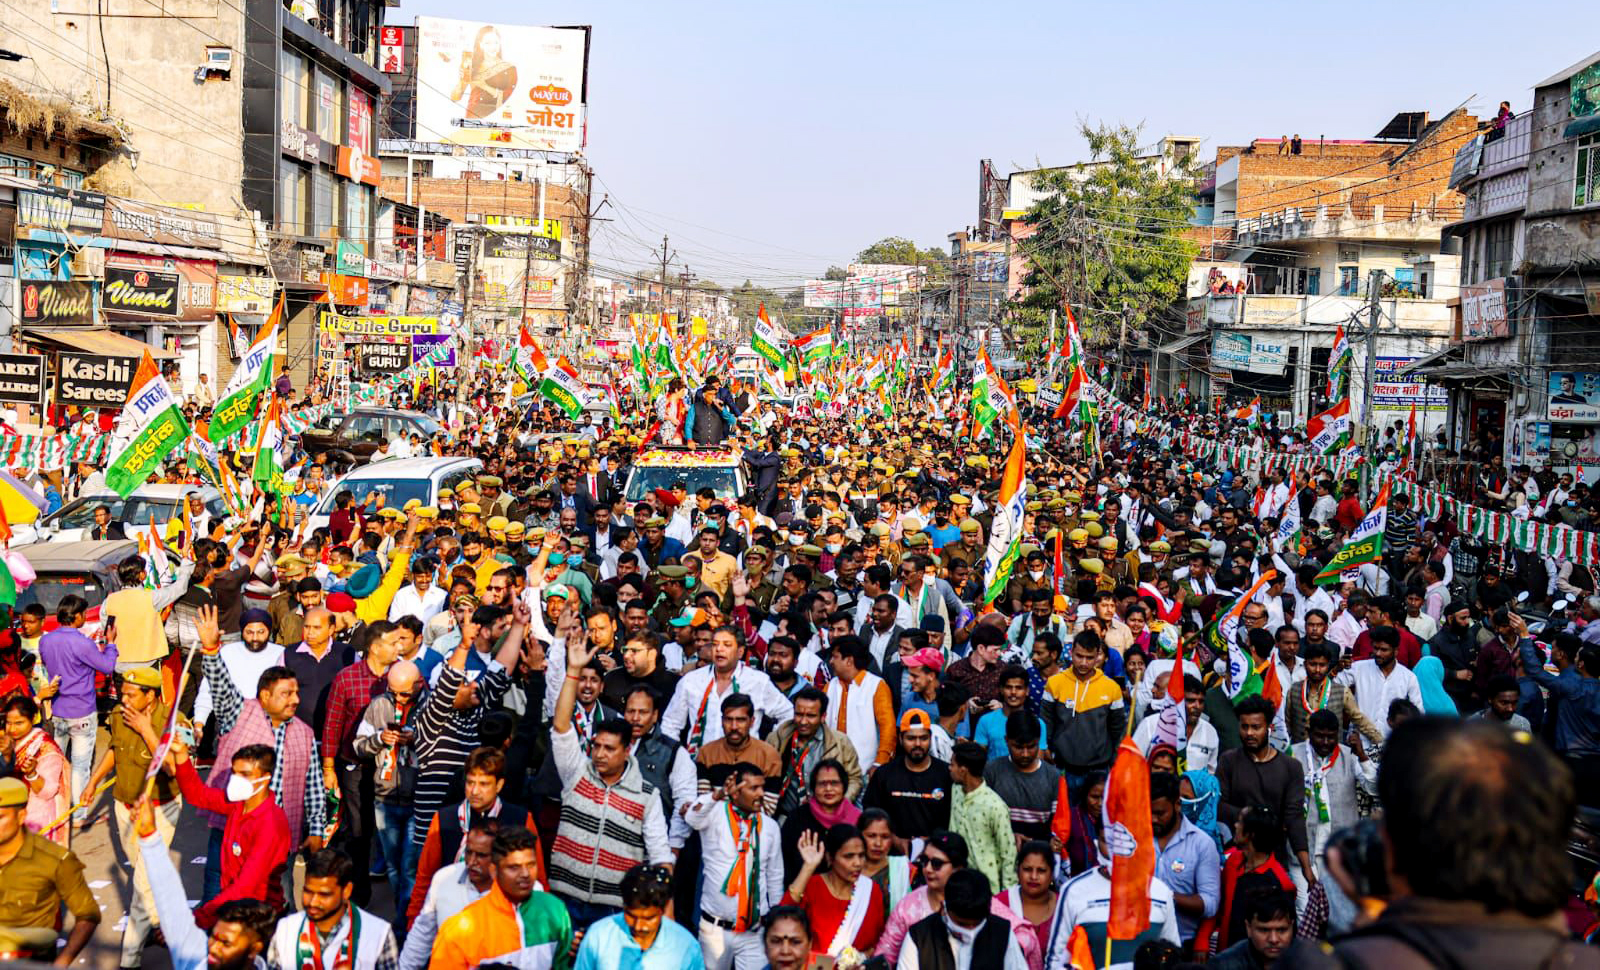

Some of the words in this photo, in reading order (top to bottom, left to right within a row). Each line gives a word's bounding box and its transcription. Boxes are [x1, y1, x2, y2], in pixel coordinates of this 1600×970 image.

[533, 90, 569, 101] MAYUR
[526, 106, 575, 128] जोश
[39, 284, 90, 318] Vinod
[105, 279, 174, 309] Vinod
[389, 319, 432, 334] Guru
[1256, 343, 1282, 353] FLEX
[62, 357, 130, 382] Kashi
[369, 357, 401, 368] GURU
[62, 382, 127, 402] Sarees
[1550, 406, 1574, 419] चंद्रा
